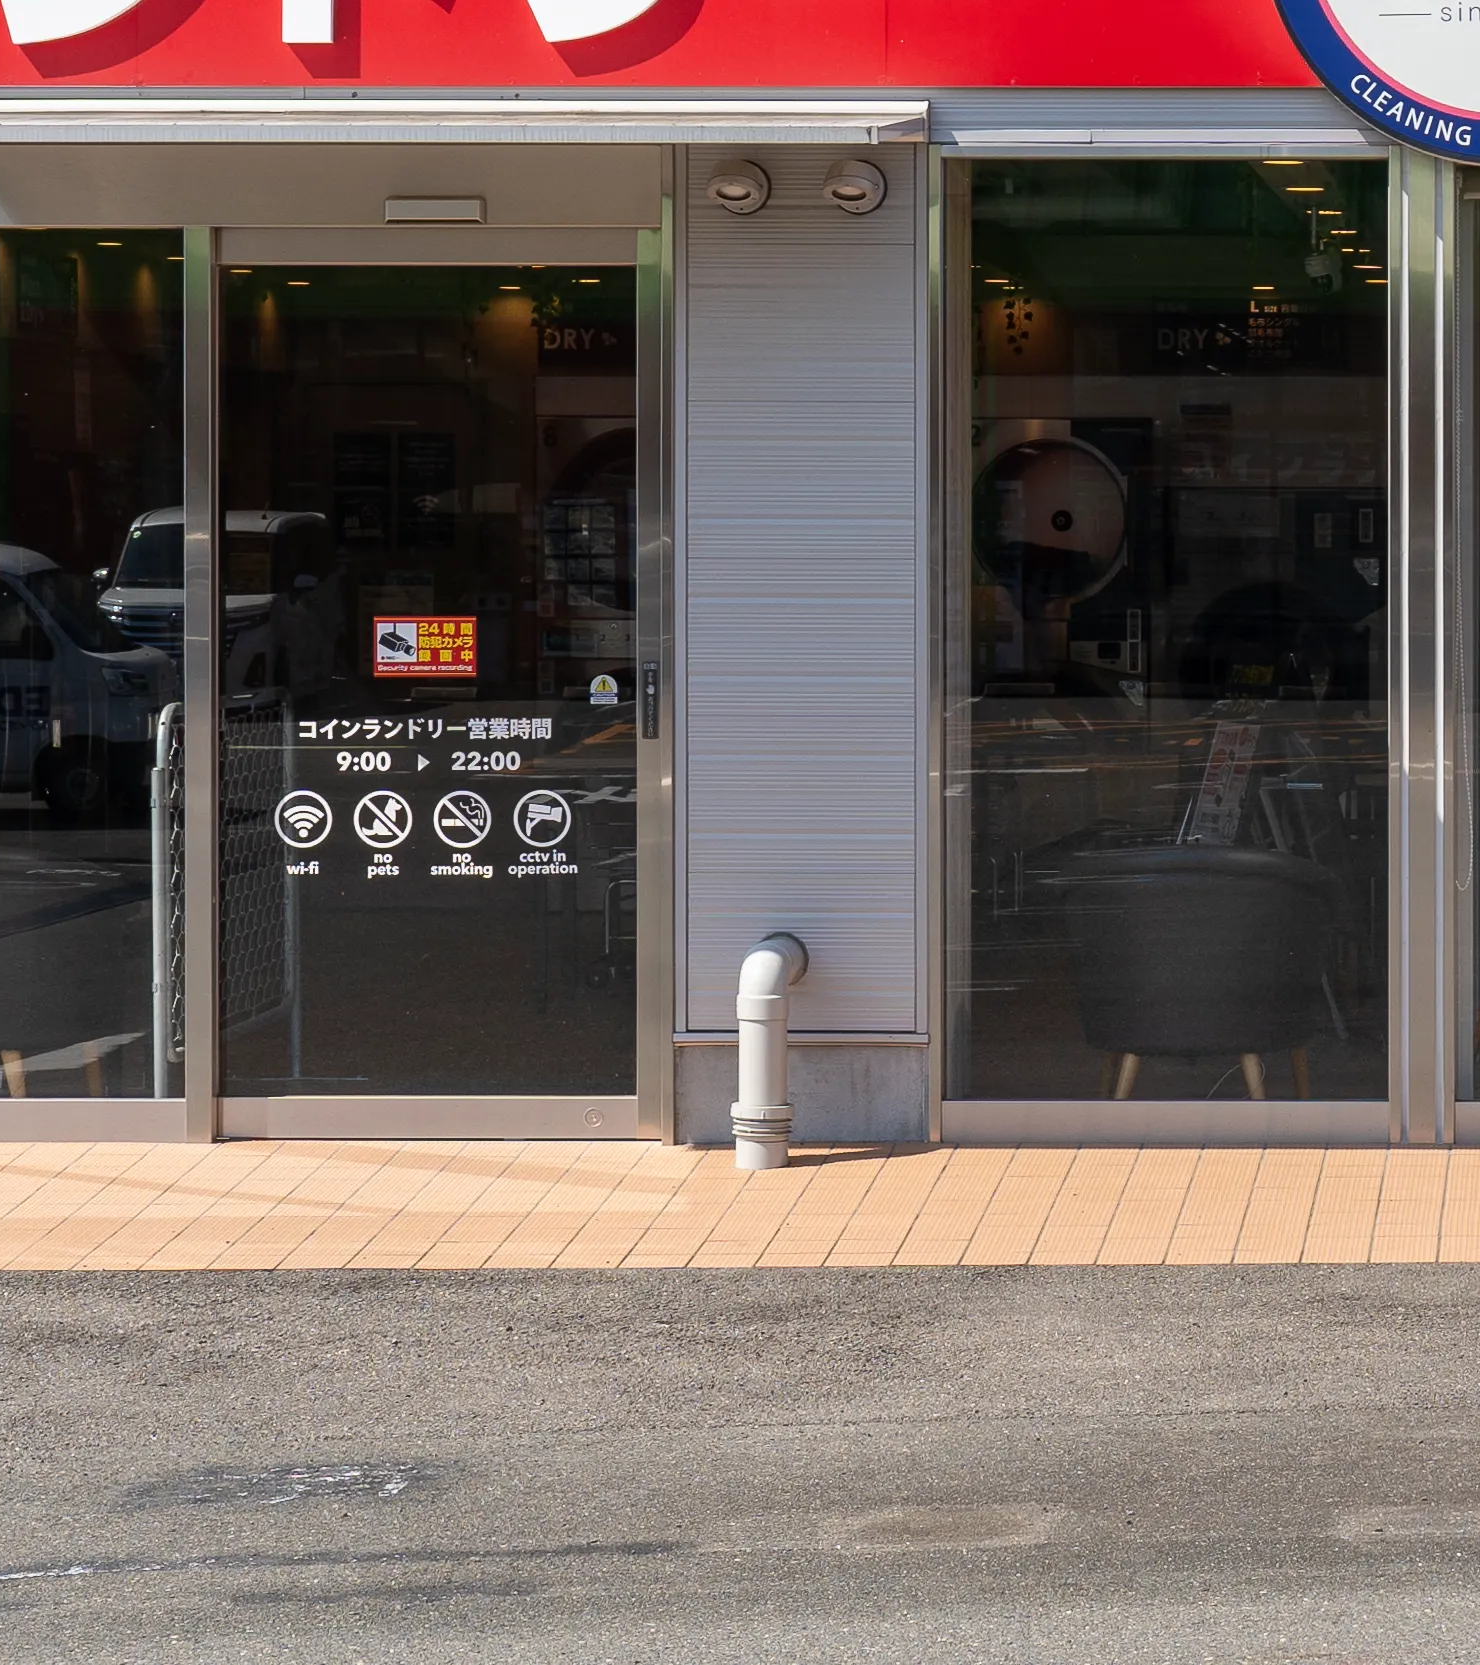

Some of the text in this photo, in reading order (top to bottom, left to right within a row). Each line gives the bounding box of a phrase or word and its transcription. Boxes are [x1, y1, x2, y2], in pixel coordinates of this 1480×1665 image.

[1349, 73, 1473, 147] CLEANING
[543, 327, 596, 350] DRY
[1157, 327, 1210, 350] DRY
[377, 664, 409, 672] Security
[298, 718, 553, 740] コインランドリー営業時間
[336, 751, 521, 772] 9:00 22:00
[373, 853, 393, 864] no
[451, 853, 472, 863] no
[519, 849, 566, 863] cctv in
[286, 861, 320, 875] wi-fi
[367, 862, 400, 879] pets
[430, 862, 495, 879] smoking
[508, 862, 579, 878] operation
